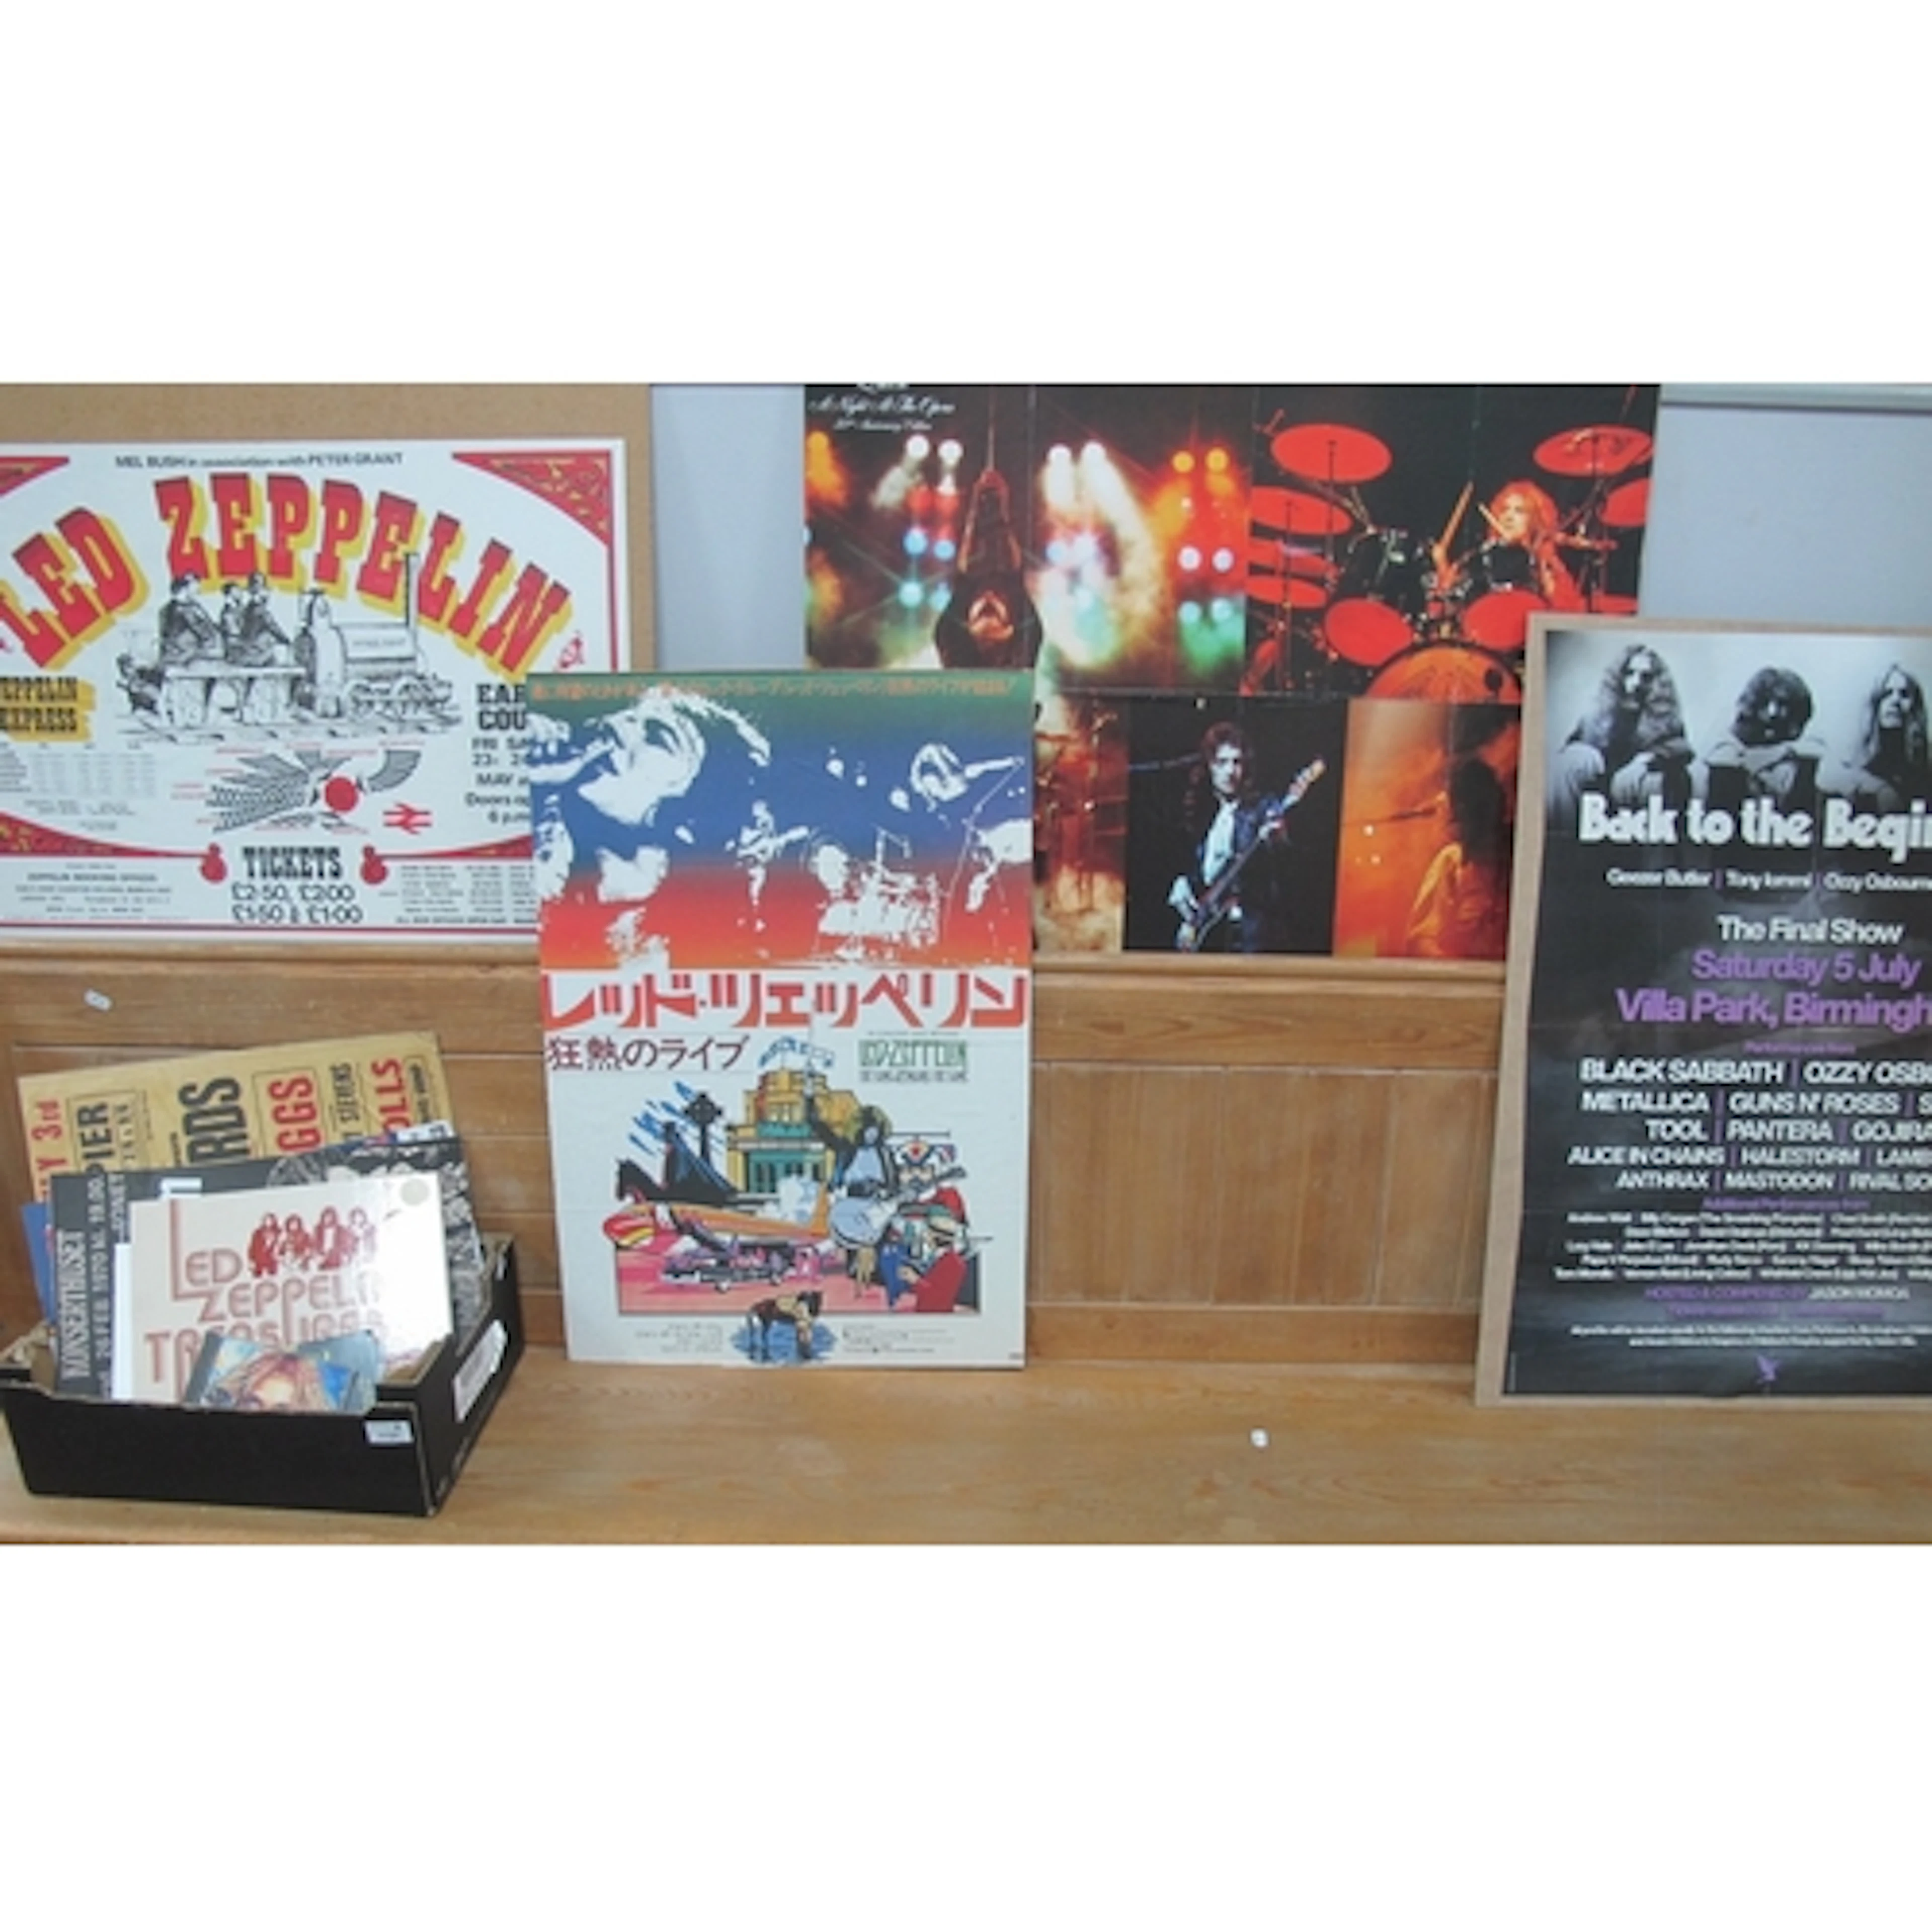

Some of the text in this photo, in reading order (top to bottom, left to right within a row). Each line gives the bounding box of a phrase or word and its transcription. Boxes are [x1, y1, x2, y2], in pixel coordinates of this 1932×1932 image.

[115, 455, 143, 468] MEL
[147, 455, 185, 468] BUSH
[202, 455, 274, 468] association
[277, 455, 305, 467] with
[308, 453, 349, 467] PETER
[354, 452, 404, 466] GRANT
[0, 472, 572, 677] LED ZEPPELIN
[479, 710, 527, 730] COU
[1578, 791, 1679, 844] Back
[1687, 798, 1734, 845] to
[1741, 797, 1813, 847] the
[243, 846, 343, 879] TICKETS
[1664, 868, 1713, 888] Butler
[1725, 872, 1762, 891] Tony
[1824, 872, 1863, 893] Ozzy
[1717, 915, 1905, 945] The Final Show
[1691, 948, 1921, 989] Saturday 5 July
[1616, 988, 1932, 1034] Villa Park, Birmingh
[548, 1035, 750, 1072] 狂熱のライブ
[1579, 1060, 1666, 1083] BLACK
[1668, 1061, 1784, 1083] SABBATH
[1804, 1061, 1874, 1083] OZZY
[371, 1058, 412, 1130] OLLS
[1581, 1091, 1711, 1112] METALLICA
[1729, 1091, 1796, 1113] GUNS
[1823, 1093, 1901, 1114] ROSES
[179, 1076, 254, 1164] RDS
[268, 1076, 328, 1153] GGS
[1645, 1120, 1709, 1141] TOOL
[1726, 1120, 1833, 1142] PANTERA
[1567, 1146, 1625, 1165] ALICE
[1628, 1147, 1646, 1165] IN
[1647, 1147, 1726, 1165] CHAINS
[1741, 1147, 1861, 1166] HALESTORM
[1614, 1171, 1711, 1189] ANTHRAX
[1724, 1171, 1835, 1190] MASTODON
[1849, 1172, 1902, 1190] RIVAL
[169, 1198, 244, 1302] LED
[56, 1230, 92, 1380] KONSERTHUSET
